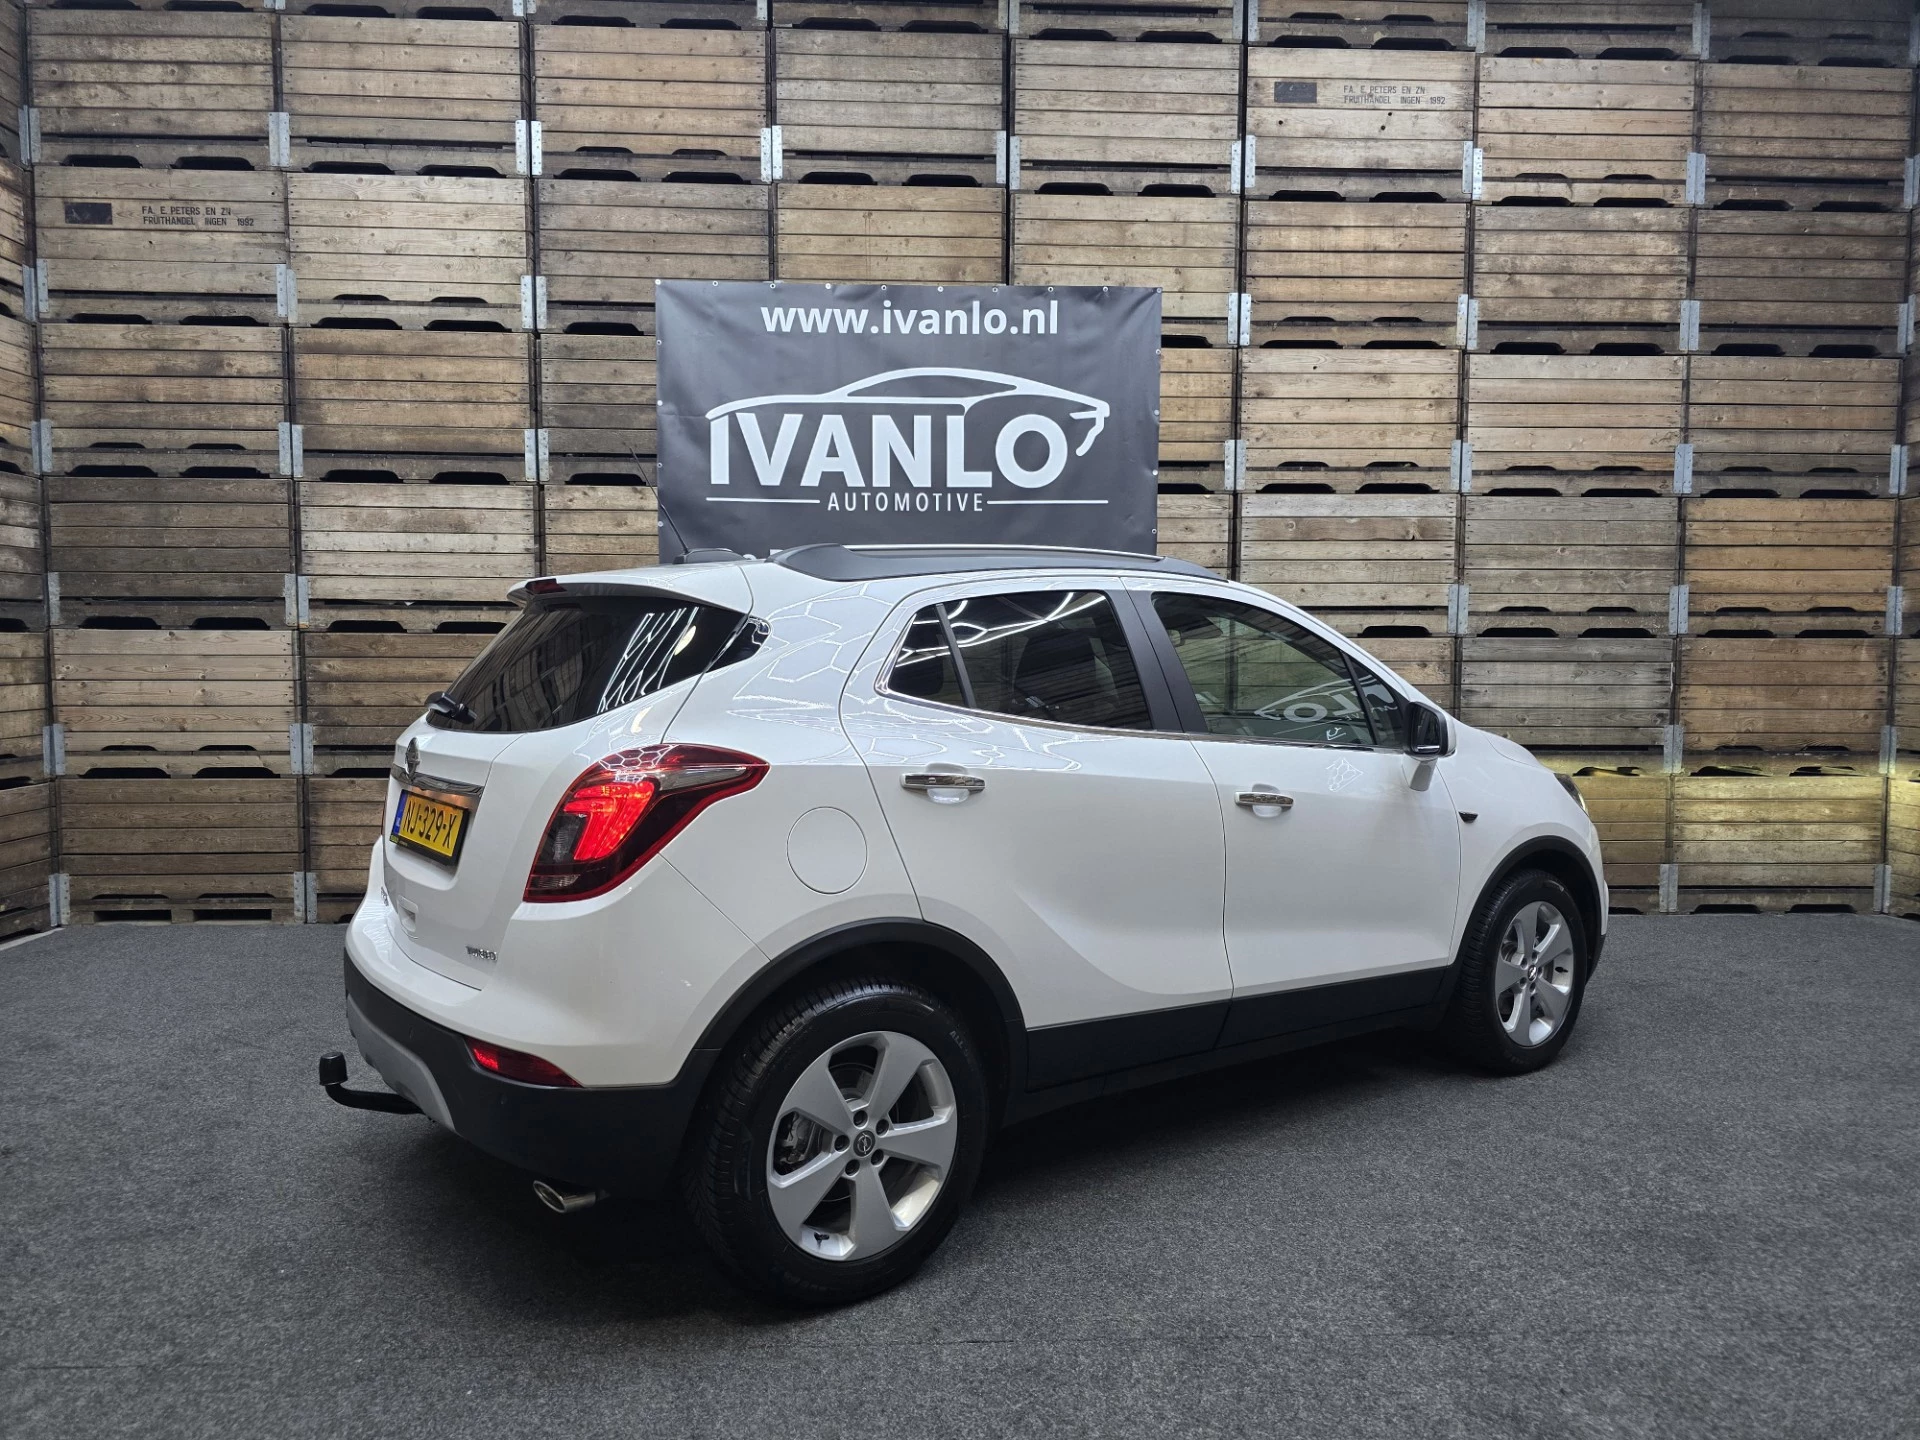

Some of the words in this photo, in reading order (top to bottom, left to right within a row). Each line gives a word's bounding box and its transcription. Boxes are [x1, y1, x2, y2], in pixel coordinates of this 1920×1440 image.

[1370, 85, 1397, 95] PETERS
[1402, 86, 1412, 95] EN
[1415, 86, 1426, 95] ZN
[1344, 95, 1391, 104] FRUITHANDEL
[1400, 96, 1421, 105] INGEN
[1430, 96, 1446, 105] 1992
[170, 207, 200, 216] PETERS
[206, 207, 216, 216] EN
[143, 216, 195, 226] FRUITHANDEL
[205, 217, 227, 226] INGEN
[237, 218, 254, 227] 1992
[761, 300, 1058, 335] www.ivanlo.nl
[709, 412, 1068, 489] IVANLO
[827, 491, 983, 513] AUTOMOTIVE
[402, 800, 457, 850] NJ-329-X
